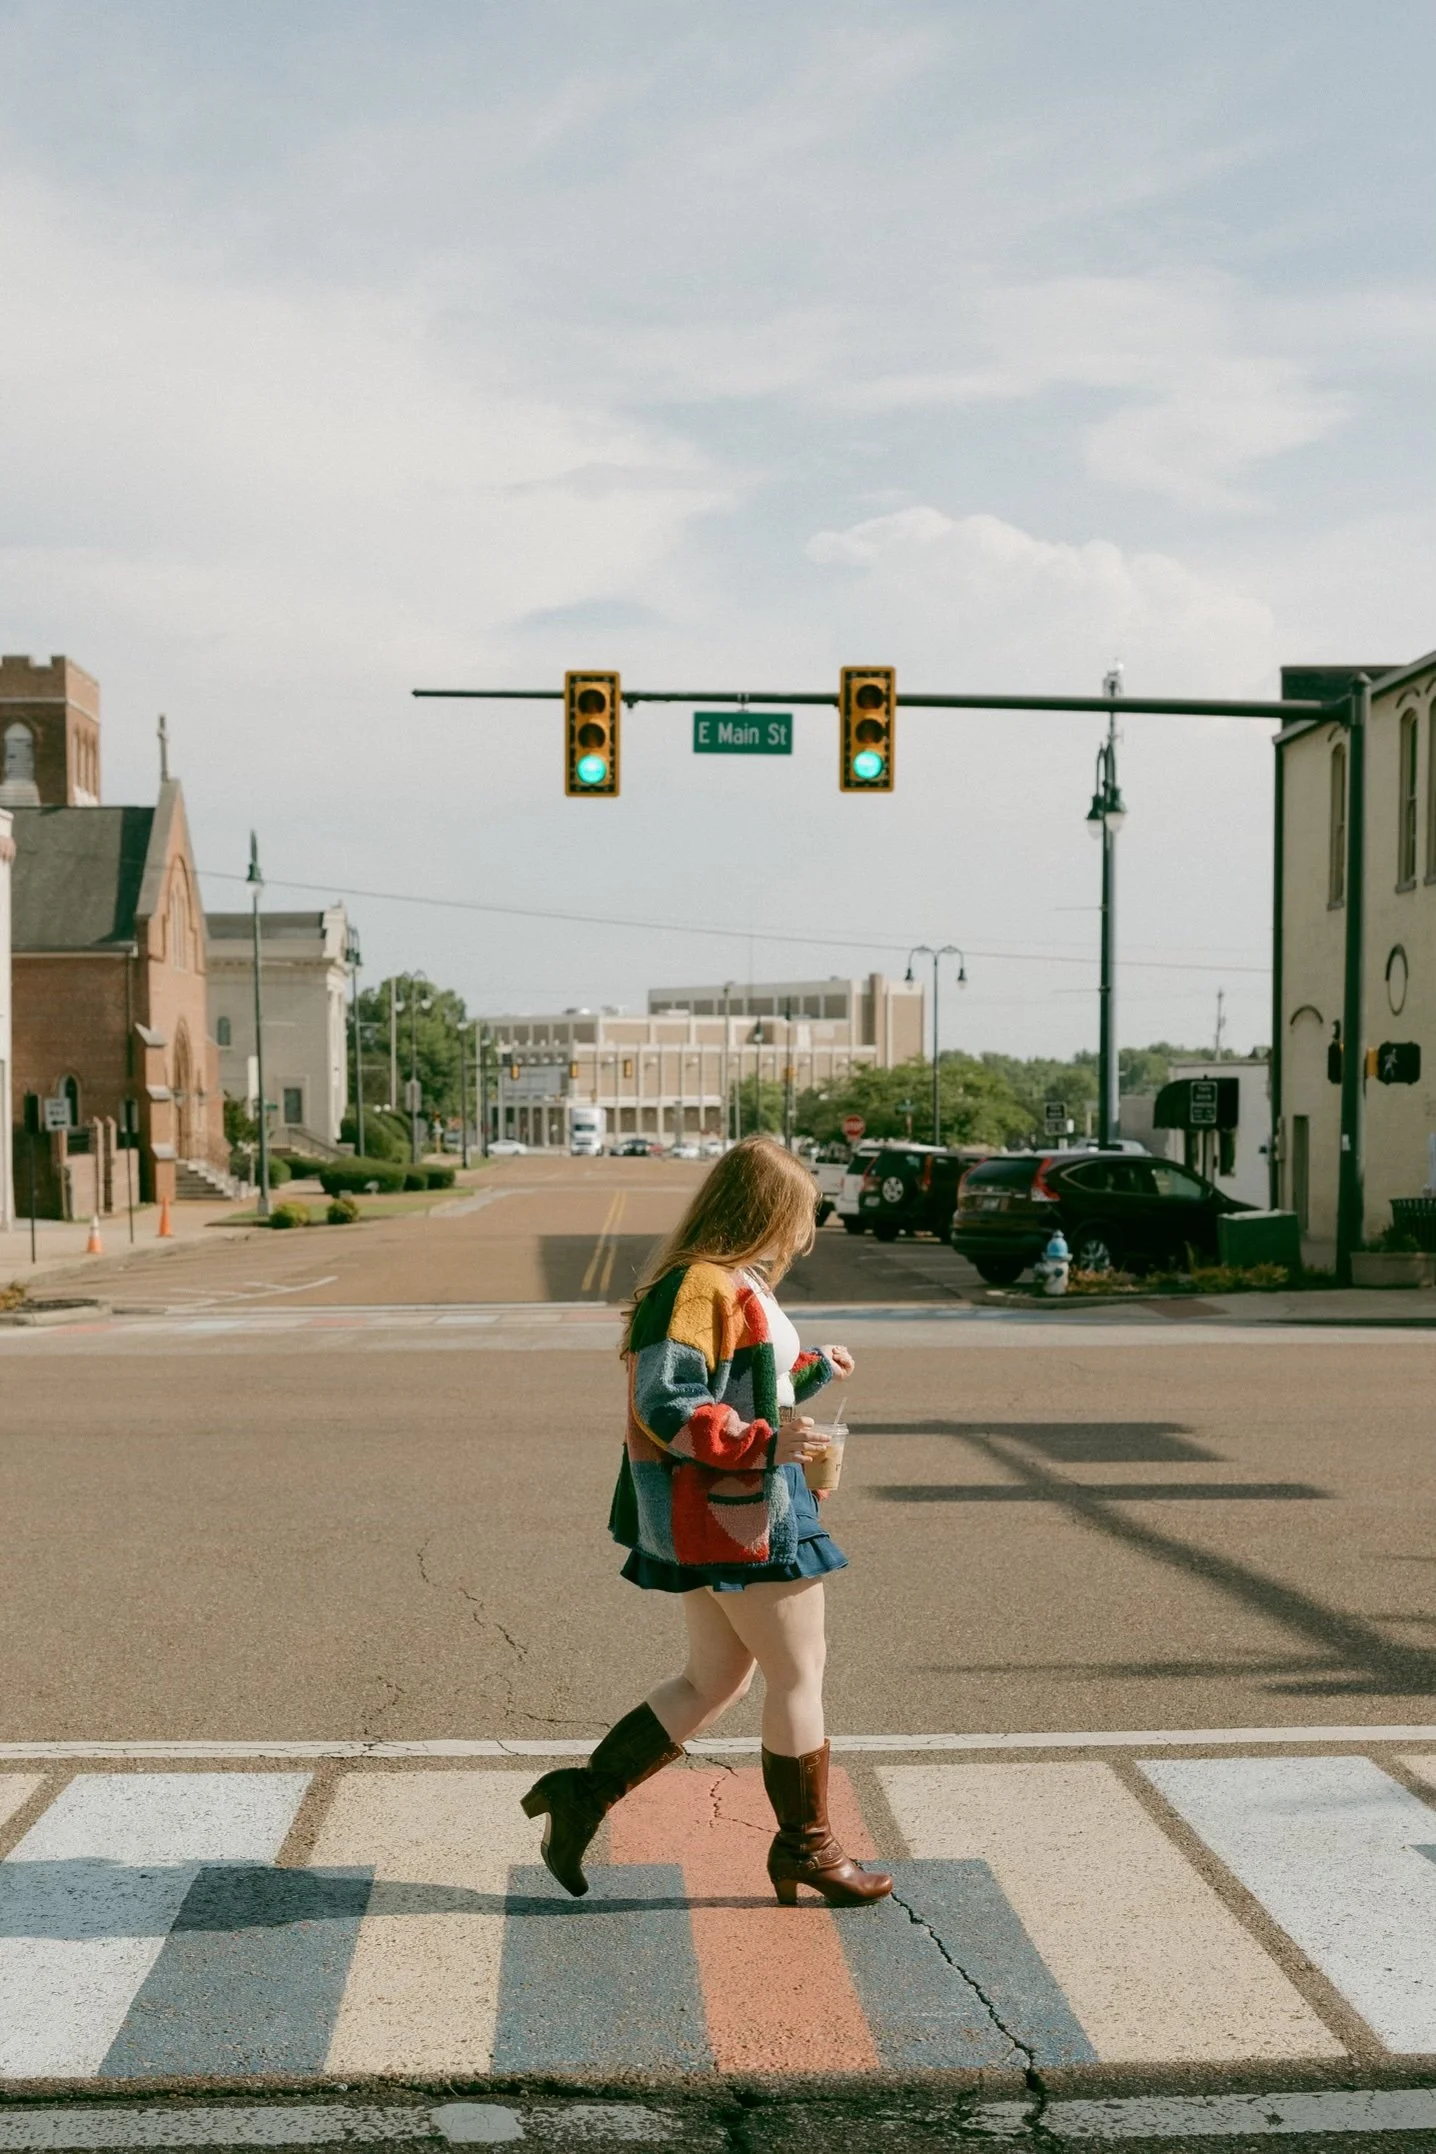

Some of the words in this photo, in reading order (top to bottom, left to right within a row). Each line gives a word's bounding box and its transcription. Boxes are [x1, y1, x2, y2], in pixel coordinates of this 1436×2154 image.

[698, 721, 710, 744] E
[718, 722, 760, 745] Main
[767, 722, 787, 746] St
